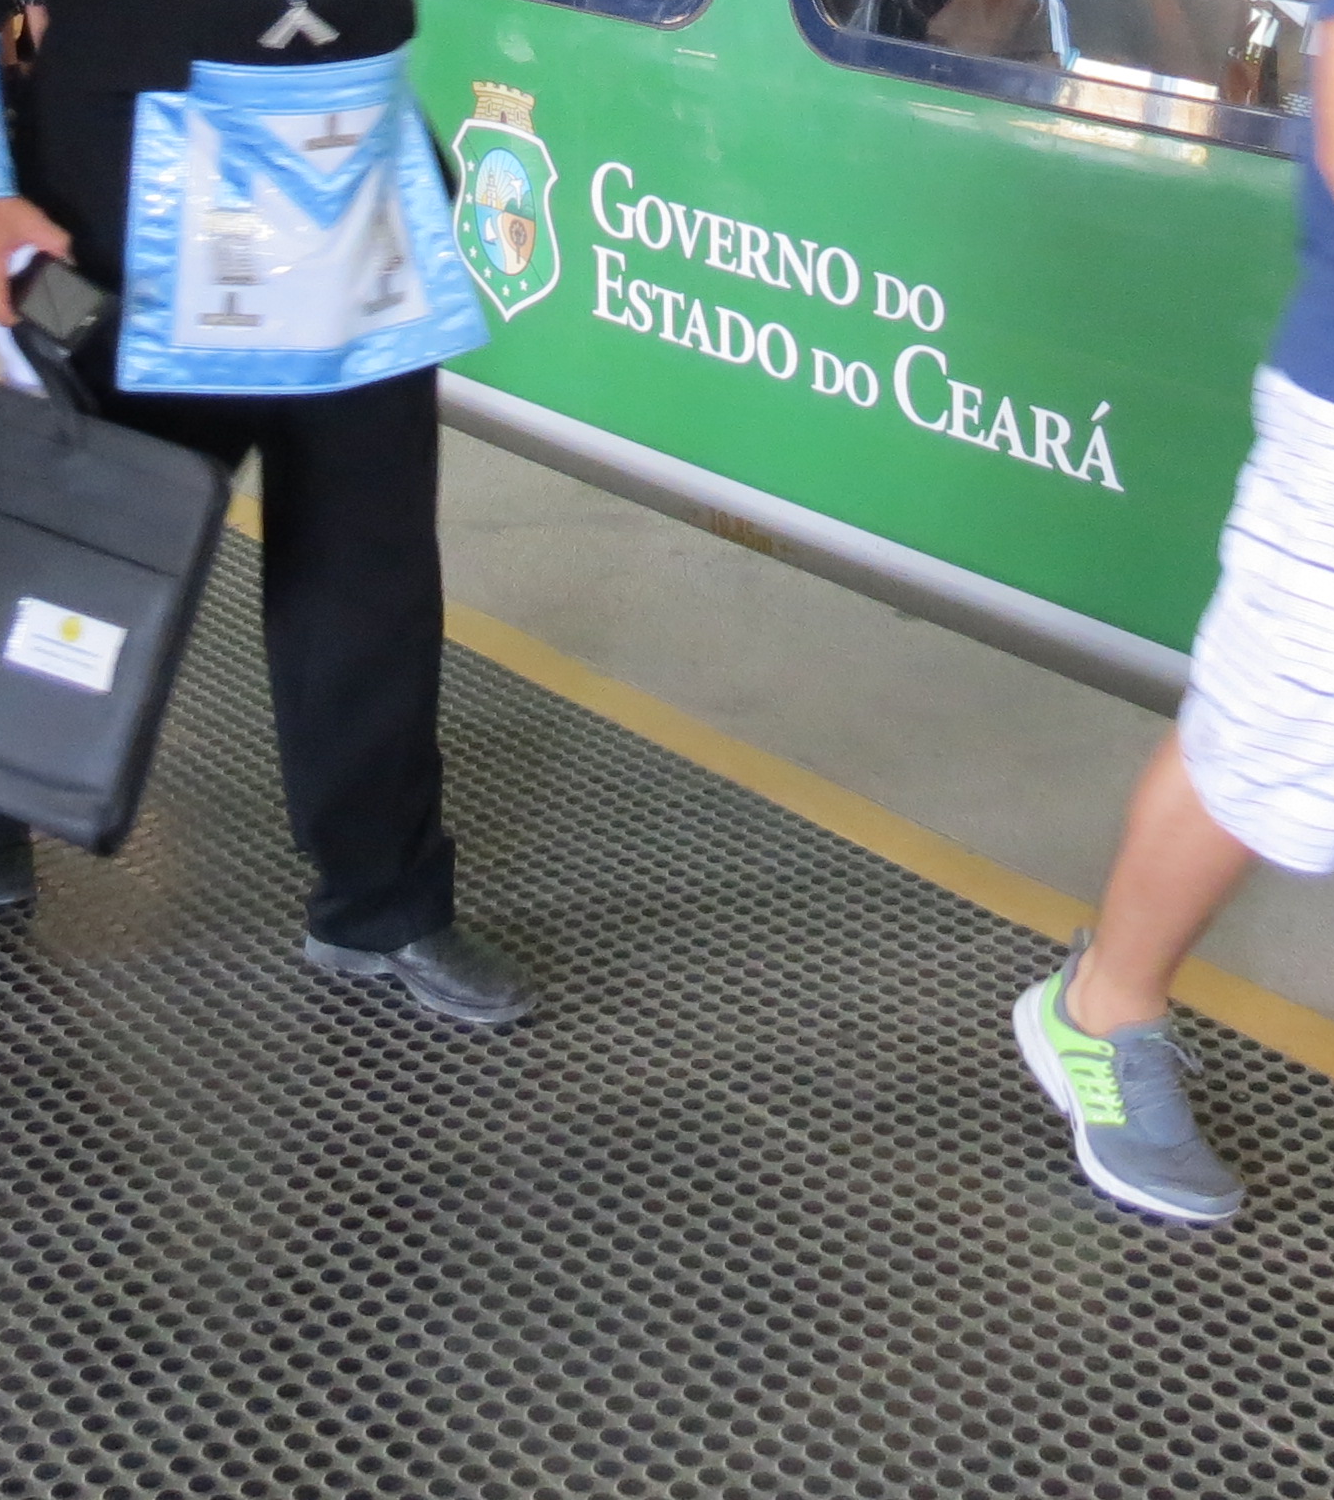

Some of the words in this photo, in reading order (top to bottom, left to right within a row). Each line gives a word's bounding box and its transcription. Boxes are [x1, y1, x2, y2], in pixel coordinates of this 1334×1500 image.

[589, 160, 861, 307] GOVERNO
[873, 270, 946, 333] DO
[591, 243, 799, 381] ESTADO
[810, 347, 880, 408] DO
[892, 343, 1126, 494] CEARÁ
